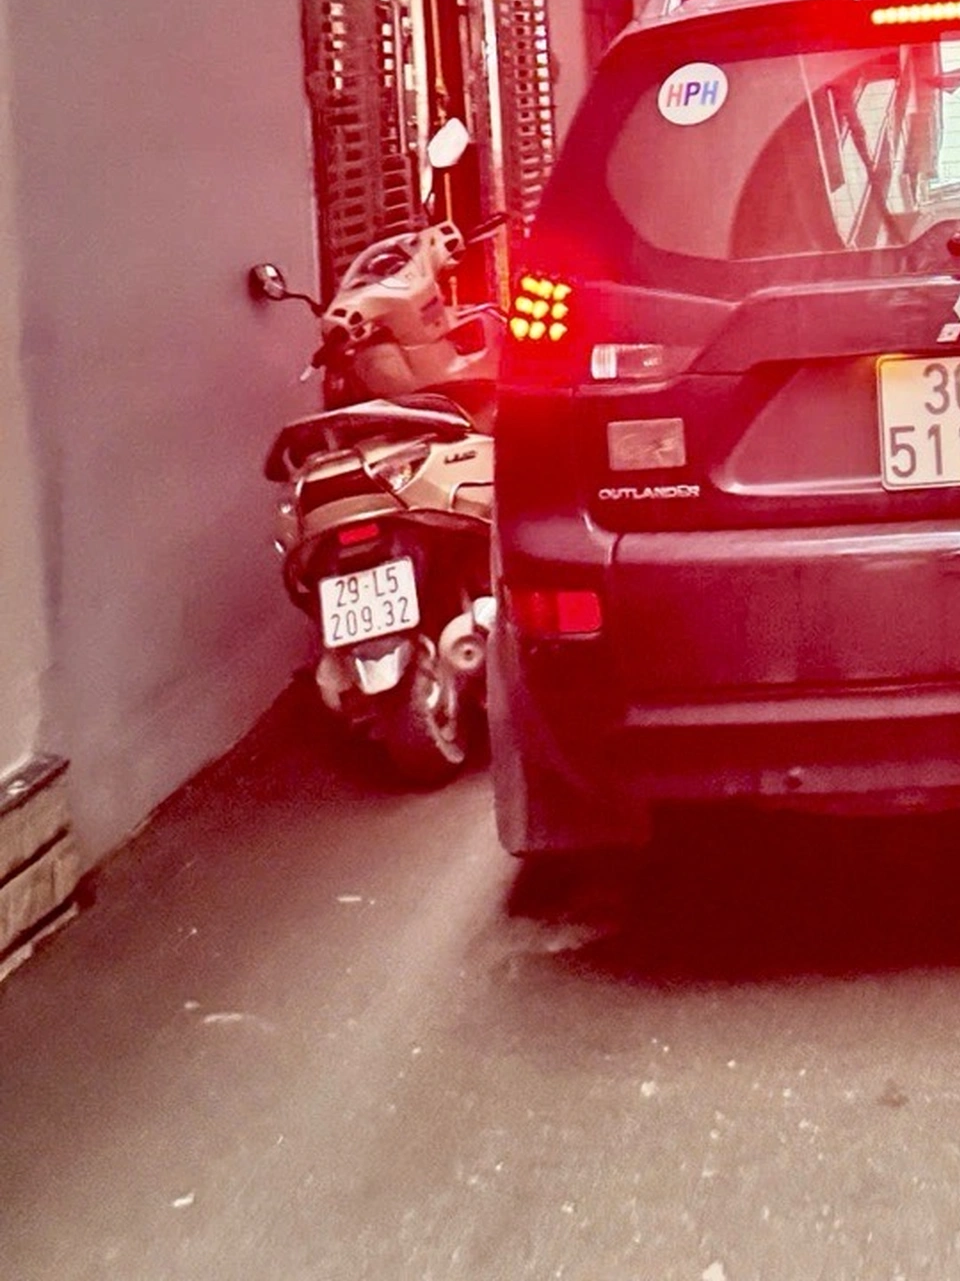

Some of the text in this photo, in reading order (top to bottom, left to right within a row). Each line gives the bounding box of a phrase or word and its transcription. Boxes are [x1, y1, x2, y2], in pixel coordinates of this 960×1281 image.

[666, 80, 720, 108] HPH
[598, 485, 700, 500] OUTLANDER
[335, 566, 399, 608] 29-L5
[330, 596, 411, 641] 209.32
